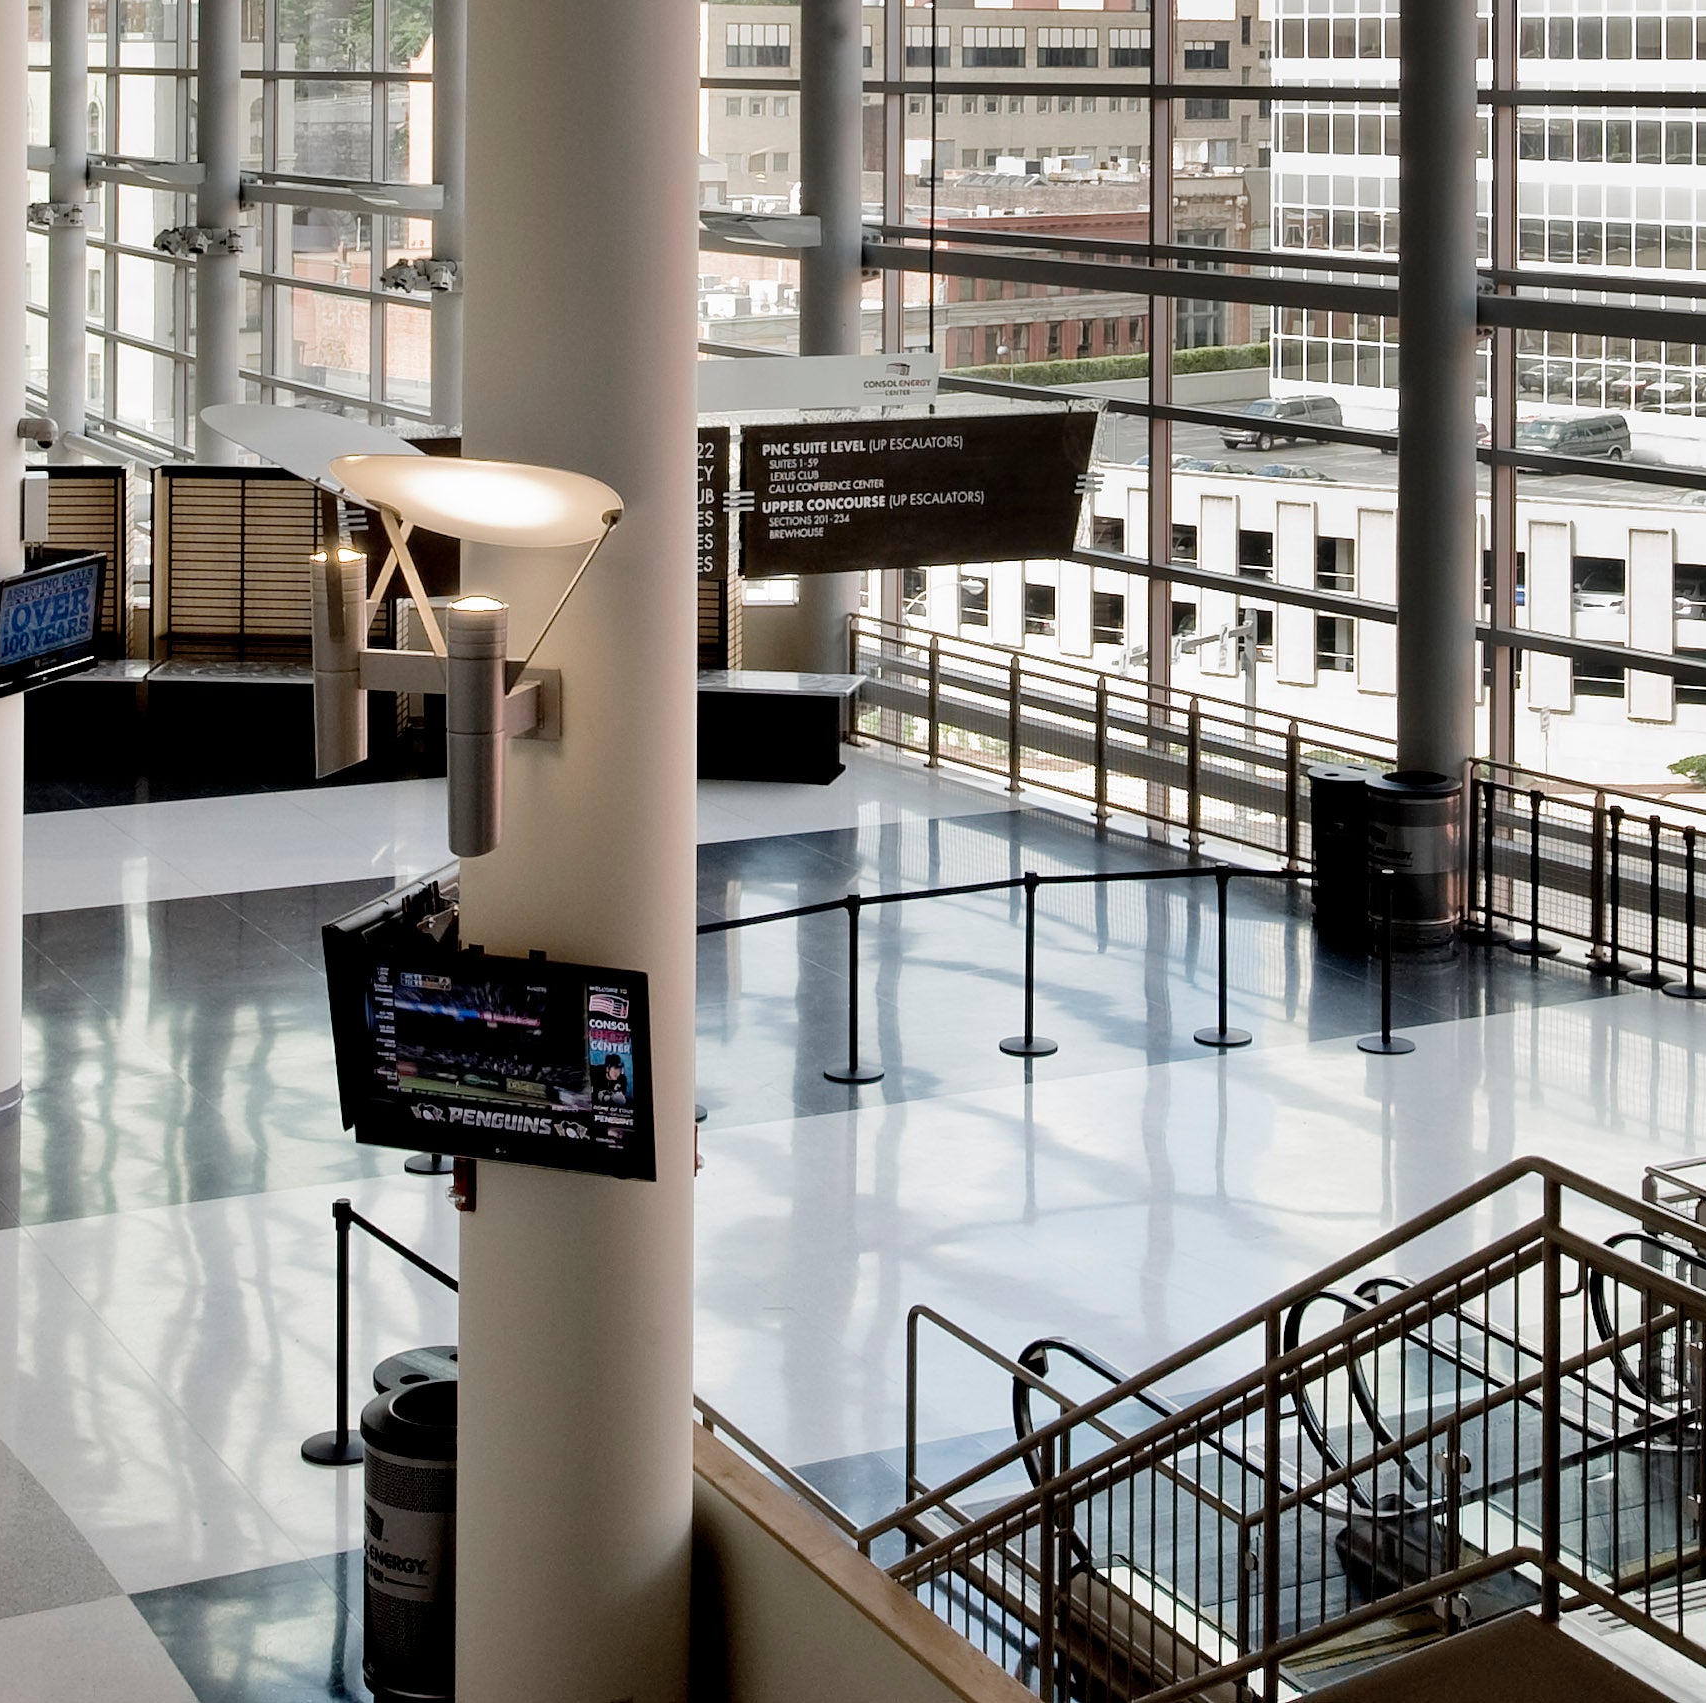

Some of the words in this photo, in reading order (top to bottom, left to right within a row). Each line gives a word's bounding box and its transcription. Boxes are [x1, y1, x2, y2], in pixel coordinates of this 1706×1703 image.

[863, 379, 898, 389] CONSOL
[899, 378, 932, 387] ENERGY
[762, 443, 790, 457] PNC
[792, 441, 828, 455] SUITE
[830, 440, 867, 454] LEVEL
[869, 438, 887, 454] (UP
[889, 435, 964, 451] ESCALATORS)
[769, 458, 797, 470] SUITES
[798, 457, 819, 468] 1-59
[770, 471, 796, 482] LEXUS
[797, 470, 819, 480] CLUB
[768, 483, 787, 495] CAL
[787, 483, 794, 494] U
[796, 480, 851, 493] CONFERENCE
[853, 478, 885, 490] CENTER
[762, 499, 804, 514] UPPER
[806, 495, 886, 512] CONCOURSE
[889, 494, 908, 509] (UP
[909, 490, 985, 507] ESCALATORS)
[769, 515, 812, 527] SECTIONS
[814, 513, 850, 525] 201-234
[769, 527, 825, 539] BREWHOUSE
[11, 587, 90, 633] OVER
[2, 631, 30, 658] 100
[589, 1018, 631, 1033] CONSOL
[591, 1040, 631, 1054] CENTER
[448, 1105, 553, 1136] PENGUINS
[369, 1545, 429, 1576] ENERGY
